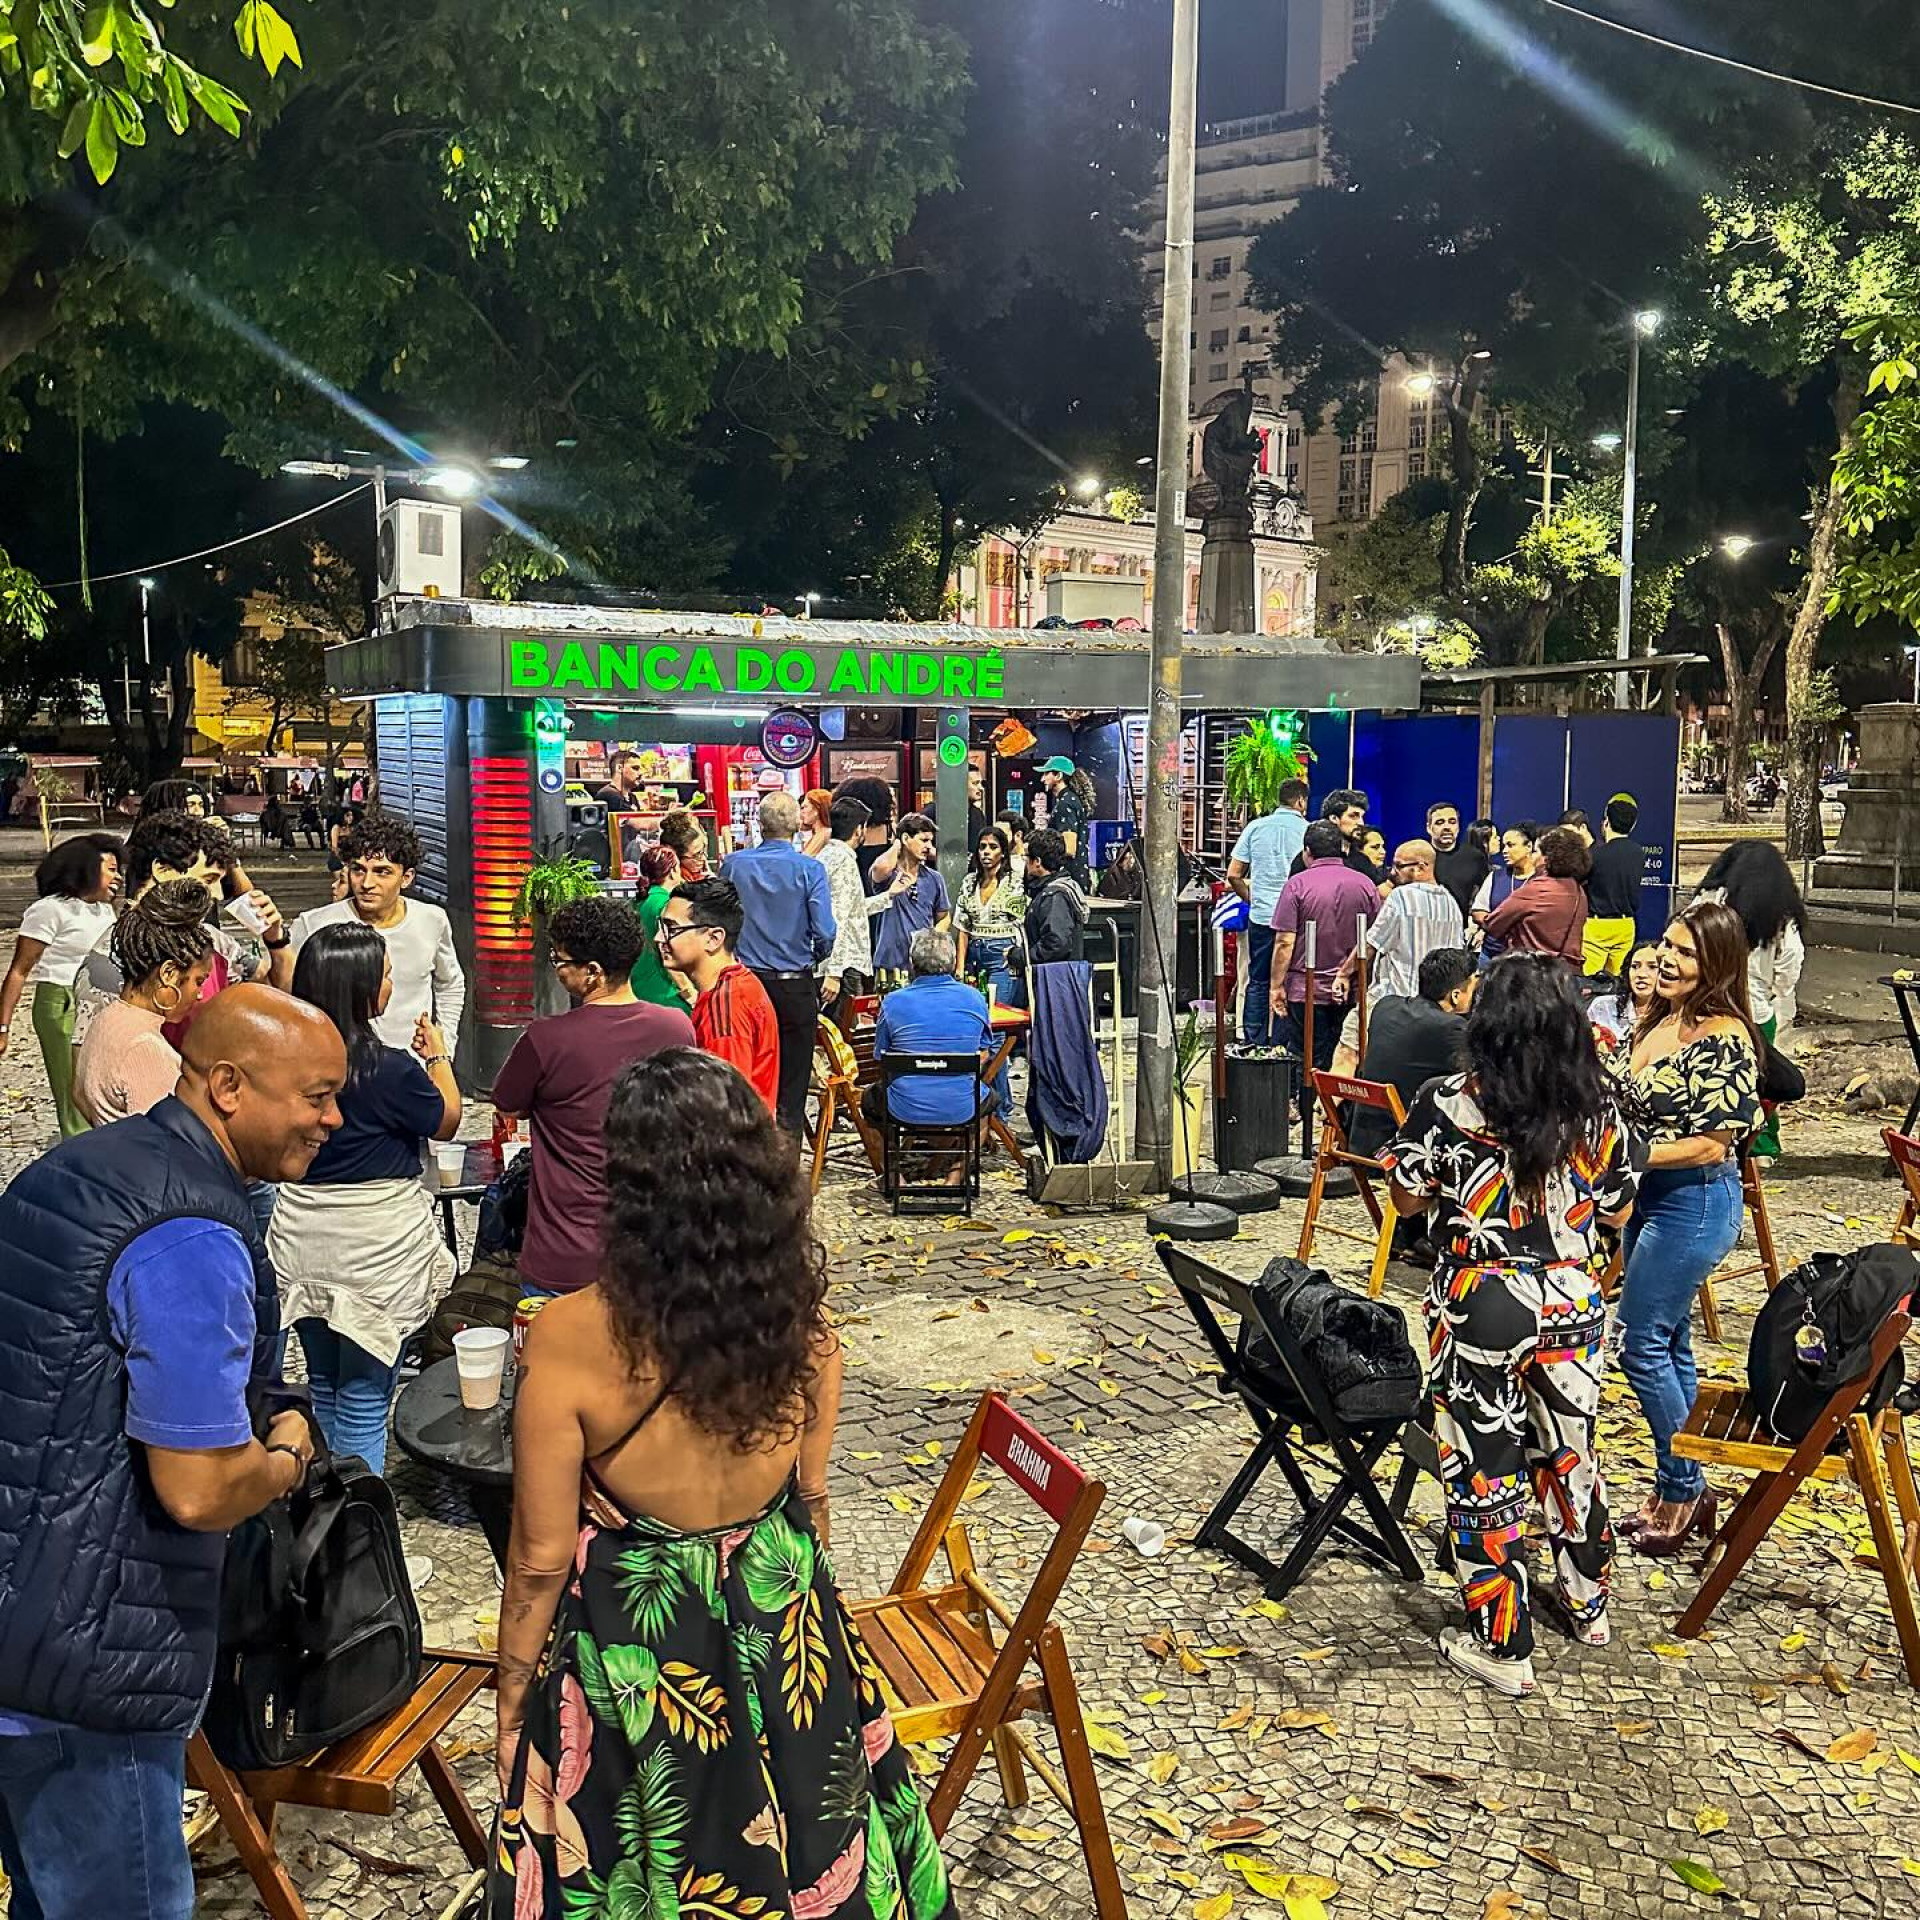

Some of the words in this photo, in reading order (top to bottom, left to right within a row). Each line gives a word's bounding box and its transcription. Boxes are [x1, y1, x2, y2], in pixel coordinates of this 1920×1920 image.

[511, 640, 724, 692] BANCA
[736, 648, 816, 692] DO
[829, 647, 1005, 698] ANDRÉ
[1007, 1433, 1052, 1492] BRAHMA
